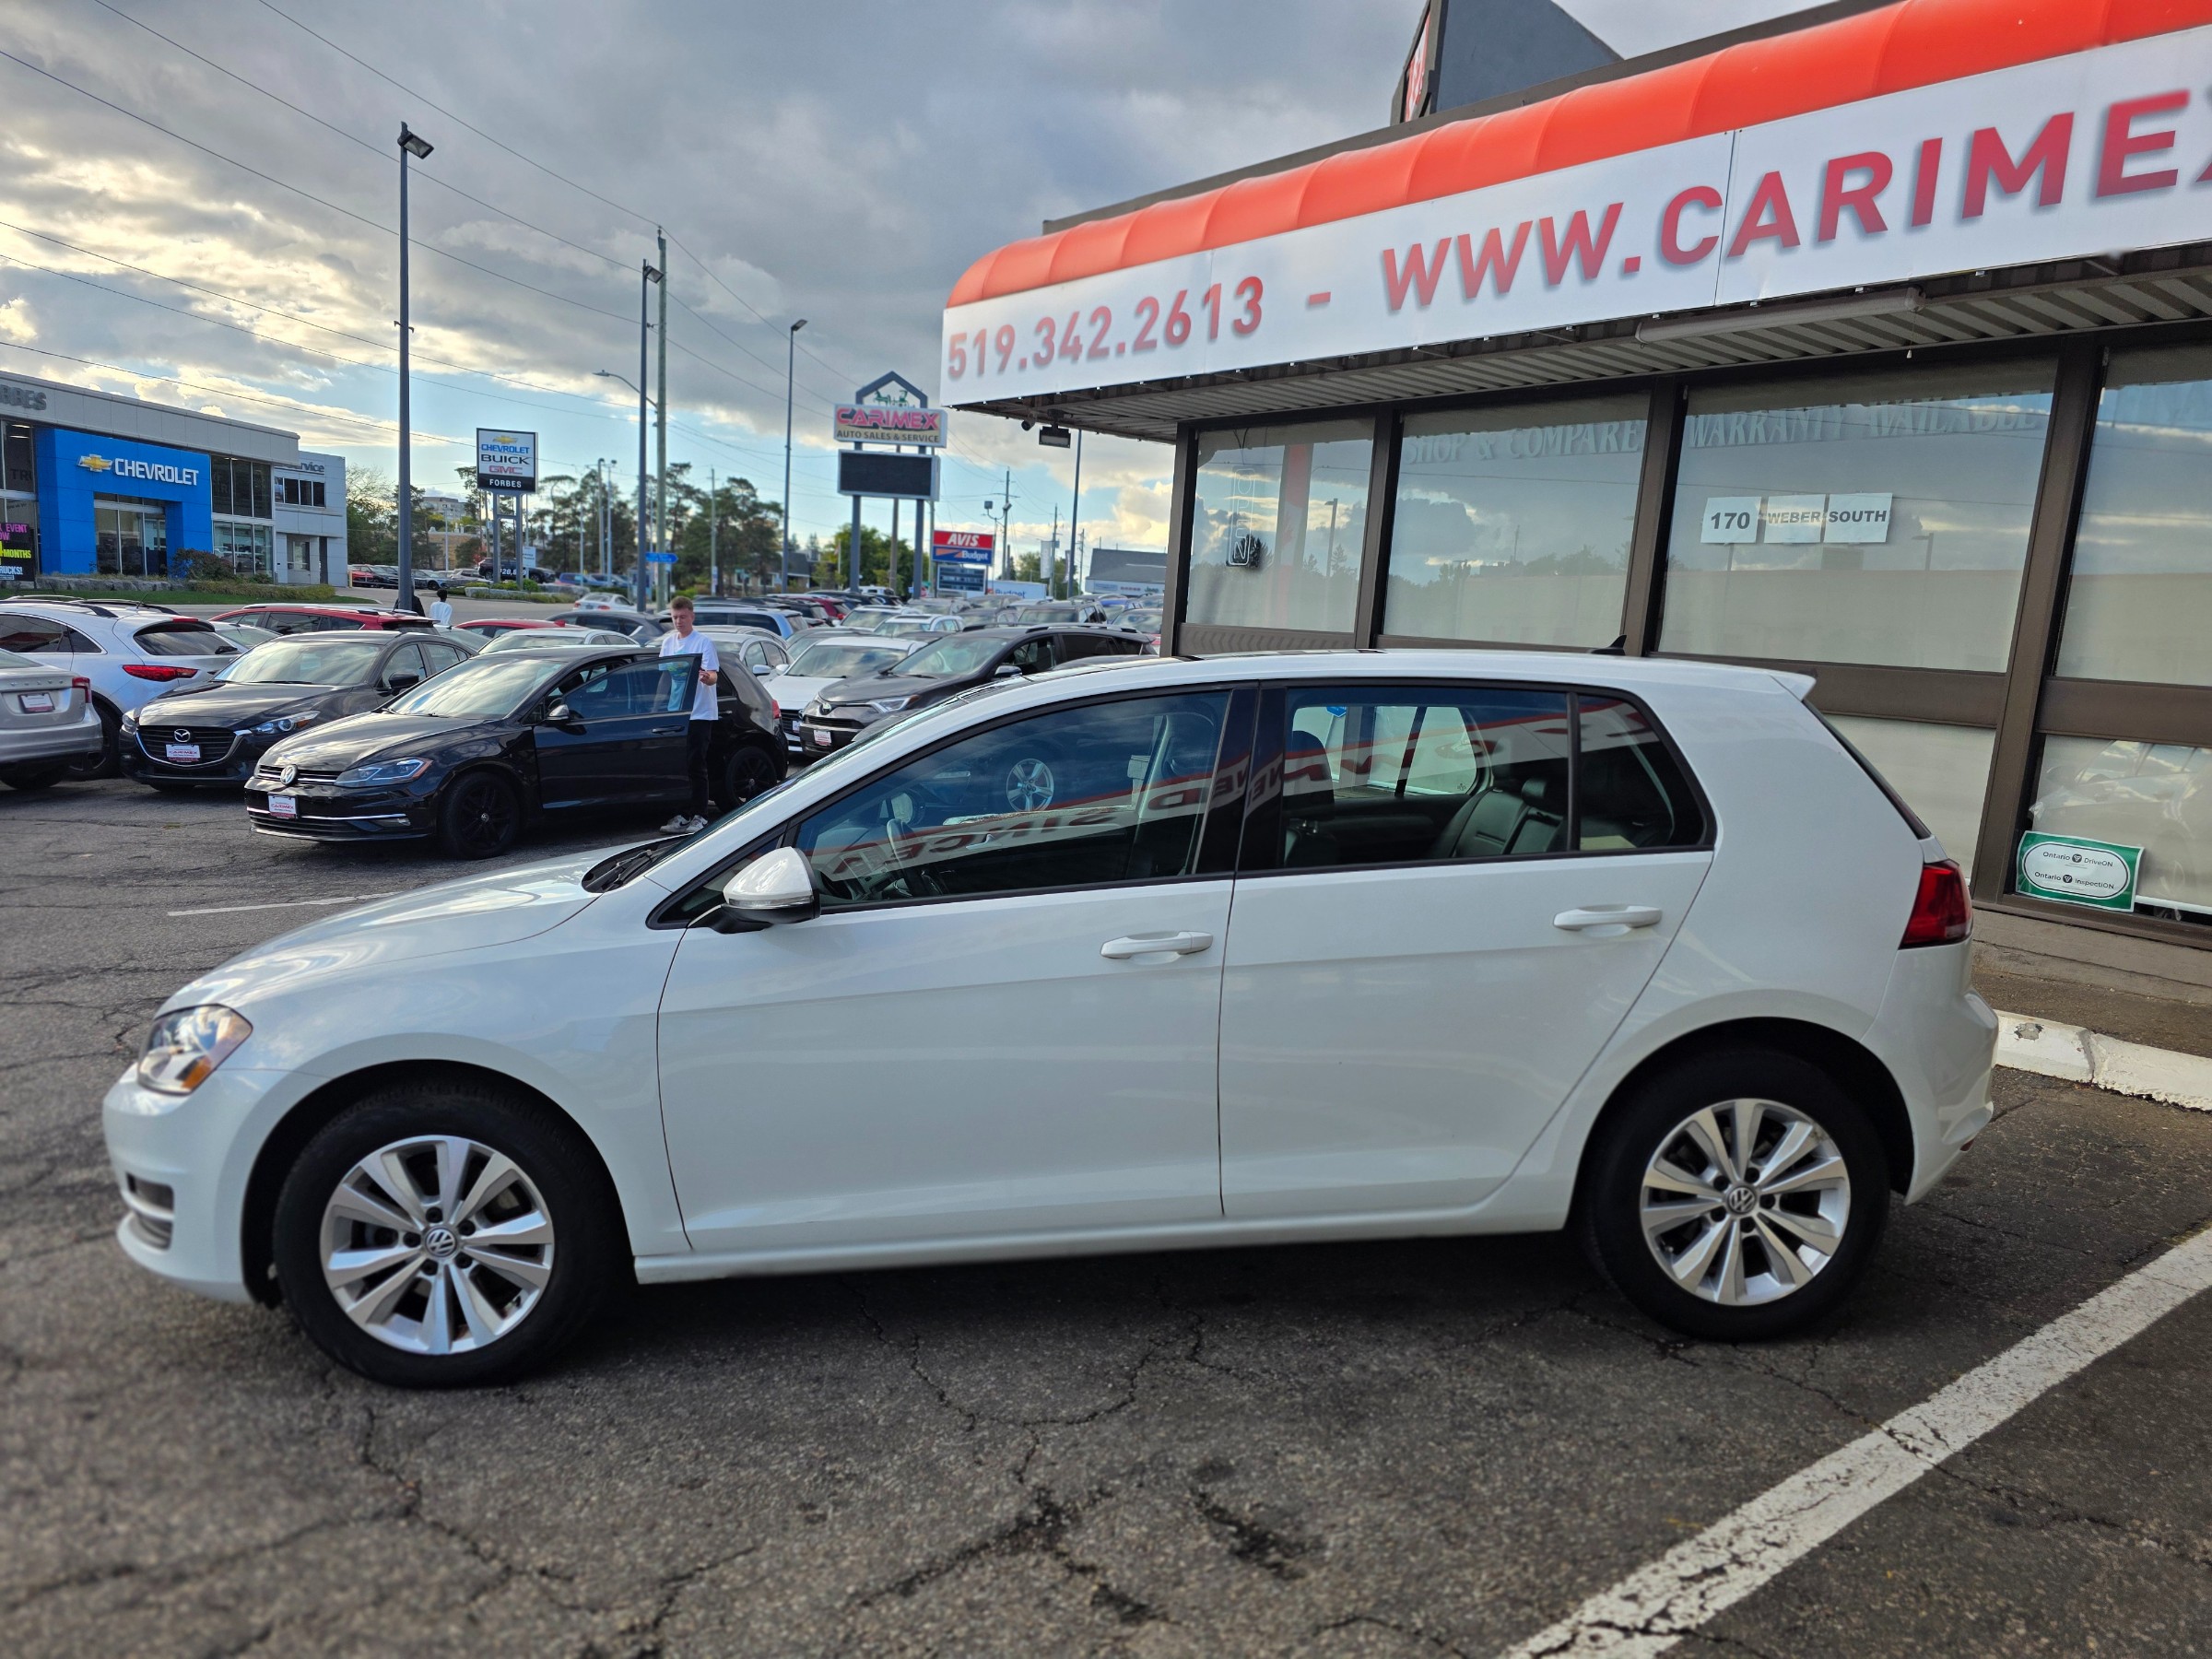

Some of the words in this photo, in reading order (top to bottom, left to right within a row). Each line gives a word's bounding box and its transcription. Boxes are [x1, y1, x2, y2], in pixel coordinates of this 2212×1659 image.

[948, 276, 1265, 378] 519.342.2613
[1382, 89, 2212, 310] WWW.CARIME
[836, 406, 940, 430] CARIMEX
[837, 429, 862, 438] AUTO
[864, 431, 891, 441] SALES
[1510, 420, 1641, 459] COMPARE
[481, 443, 530, 454] CHEVROLET
[480, 453, 533, 465] BUICK
[114, 457, 199, 486] CHEVROLET
[488, 465, 524, 475] GMC
[489, 478, 522, 488] FORBES
[1710, 512, 1750, 531] 170
[1767, 510, 1821, 524] WEBER
[1828, 510, 1888, 524] SOUTH
[6, 524, 28, 533] EVENT
[947, 533, 979, 547] AVIS
[3, 548, 32, 559] MONTHS
[962, 550, 988, 560] Budget
[2042, 851, 2071, 861] Ontario
[2084, 857, 2113, 867] DriveON
[2034, 871, 2061, 881] Ontario
